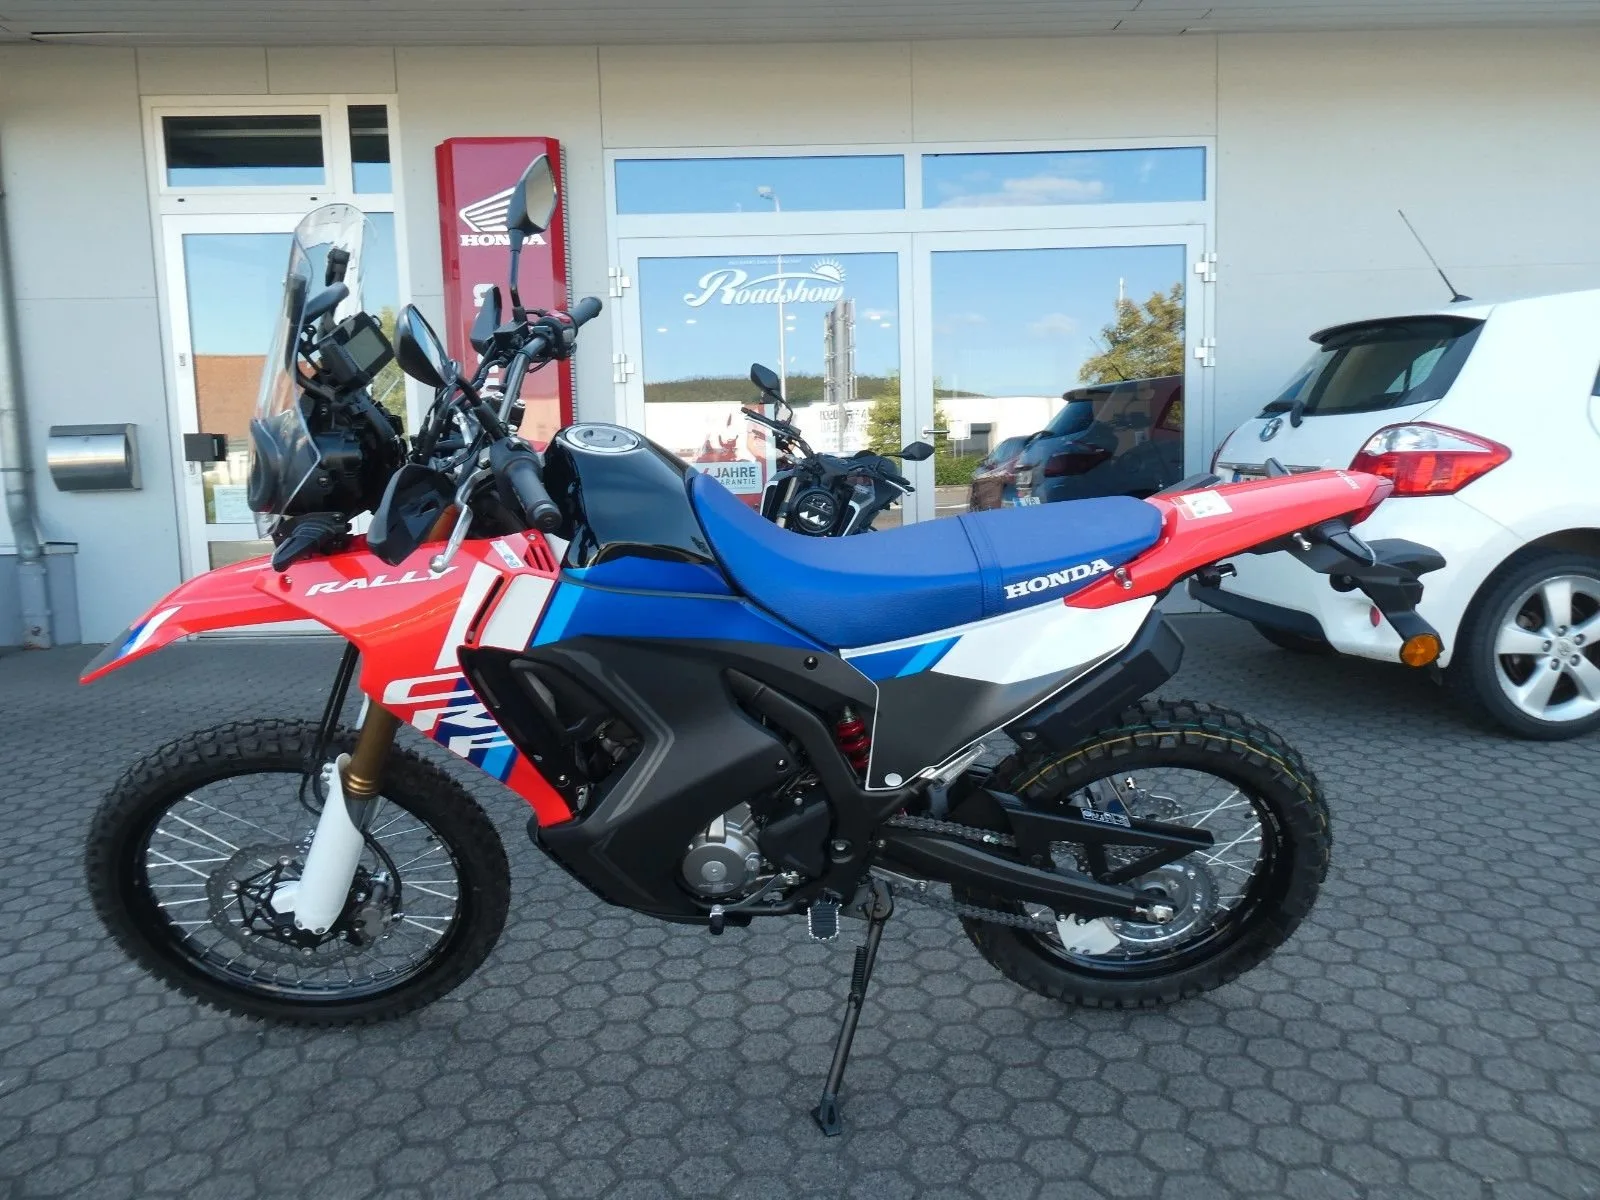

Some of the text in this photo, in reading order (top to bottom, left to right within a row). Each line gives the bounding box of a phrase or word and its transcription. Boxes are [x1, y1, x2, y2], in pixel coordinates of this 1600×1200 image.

[460, 234, 547, 246] HONA
[684, 268, 844, 307] Roadshow
[714, 466, 756, 479] JAHRE
[720, 478, 756, 486] ARANTIE
[304, 566, 459, 597] RALLY
[1003, 558, 1114, 599] HONDA
